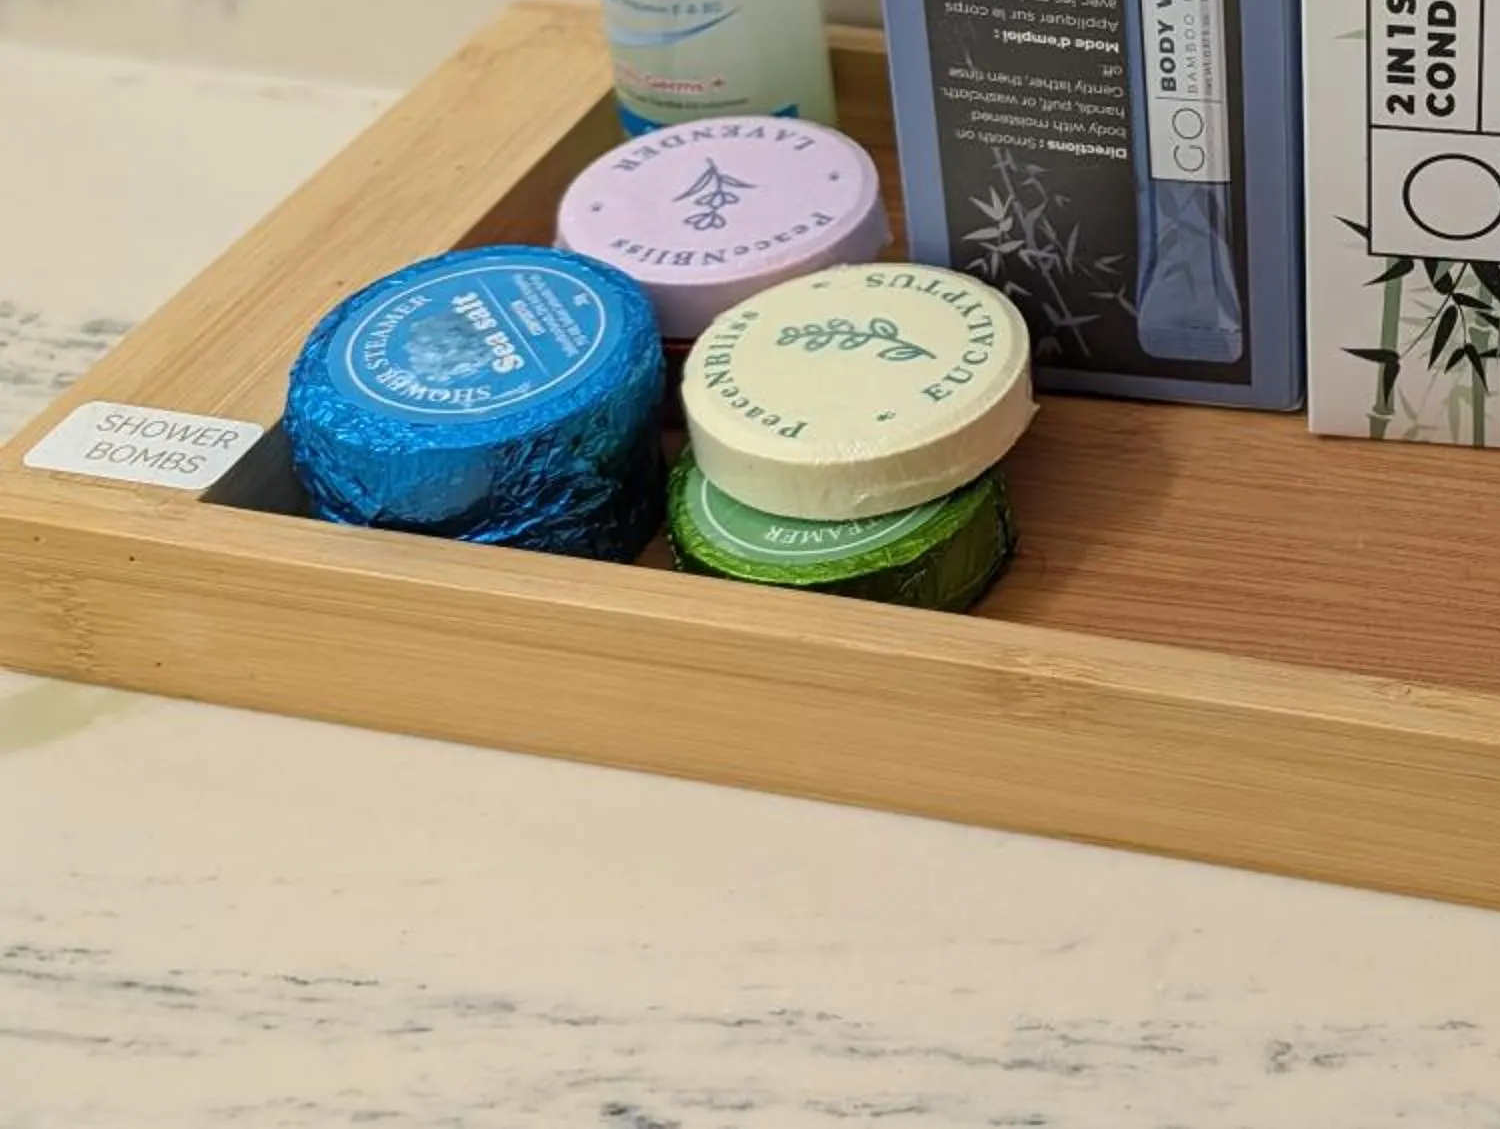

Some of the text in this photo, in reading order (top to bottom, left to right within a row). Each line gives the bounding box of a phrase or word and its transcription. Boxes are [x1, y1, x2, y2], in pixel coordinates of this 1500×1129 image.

[944, 1, 1119, 32] Appliquer sur le corps
[1386, 24, 1416, 38] 1
[1002, 29, 1072, 49] d'emploi
[1074, 39, 1120, 54] Mode
[1183, 13, 1199, 94] BAMBOO
[1157, 19, 1177, 92] BODY
[1386, 47, 1415, 85] IN
[948, 67, 985, 82] rinse
[987, 73, 1023, 87] then
[1075, 81, 1125, 98] Gently
[1020, 96, 1037, 107] or
[1386, 94, 1415, 115] 2
[956, 128, 976, 140] on
[971, 109, 1127, 139] body with moistened
[1172, 107, 1206, 172] GO
[612, 123, 817, 173] LAVENDER
[978, 131, 1036, 150] Smooth
[1047, 139, 1128, 160] Directions
[608, 211, 834, 267] PeaceNBliss
[363, 294, 433, 371] STEAMER
[451, 292, 526, 374] Sea salt
[865, 271, 997, 404] EUCALYPTUS
[375, 371, 492, 403] SHOWER
[704, 309, 808, 440] PeaceNBliss
[96, 414, 240, 450] SHOWER
[85, 441, 208, 475] BOMBS
[764, 519, 868, 546] EAMER
